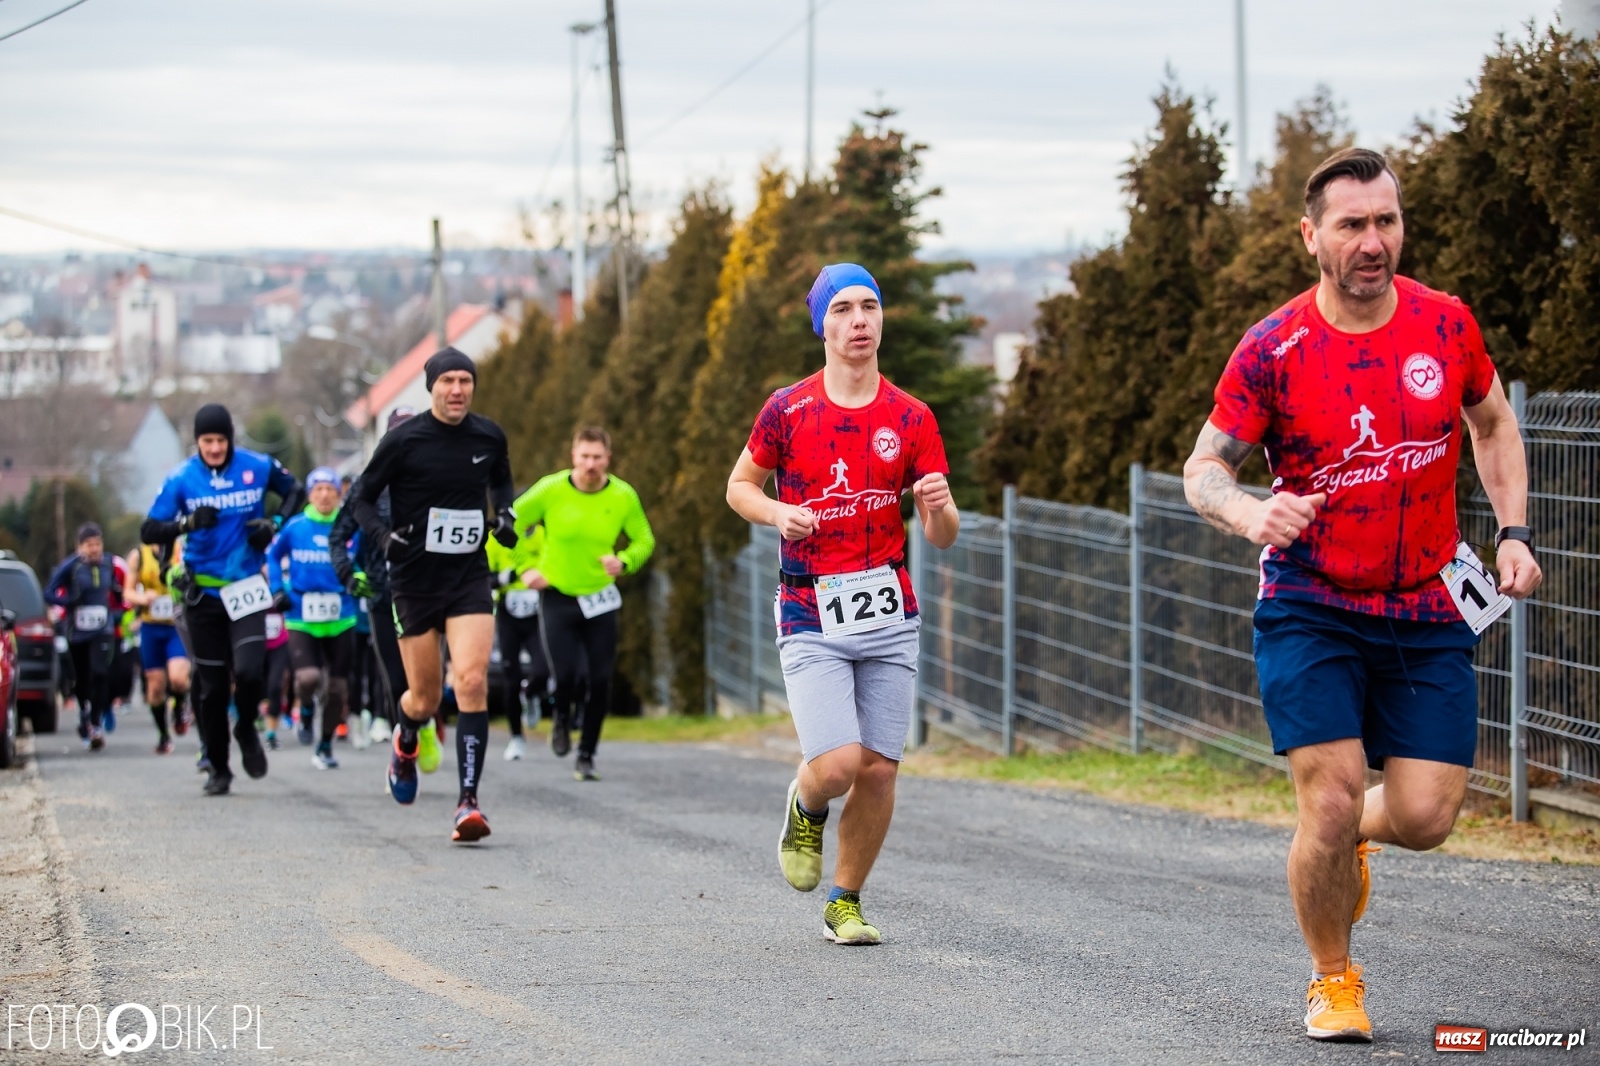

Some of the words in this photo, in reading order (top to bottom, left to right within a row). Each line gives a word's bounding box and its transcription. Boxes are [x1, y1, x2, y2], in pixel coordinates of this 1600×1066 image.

[1398, 442, 1448, 473] Team
[433, 525, 480, 545] 155
[229, 587, 268, 612] 202
[826, 586, 899, 625] 123
